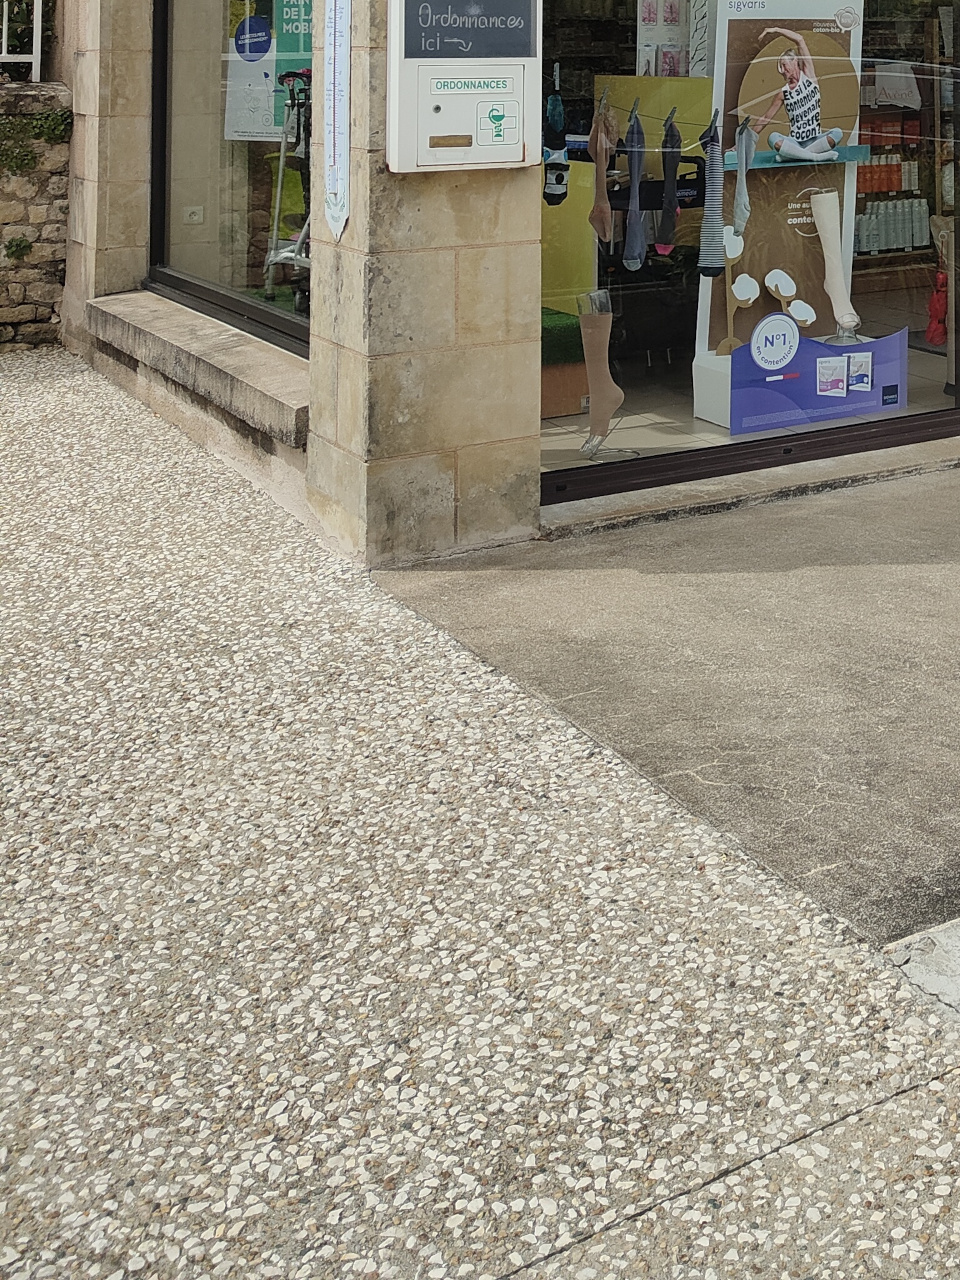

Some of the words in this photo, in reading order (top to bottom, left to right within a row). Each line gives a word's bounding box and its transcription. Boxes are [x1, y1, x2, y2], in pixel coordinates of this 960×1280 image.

[283, 7, 299, 19] DE
[418, 3, 524, 29] Ordonnances
[421, 33, 440, 51] ici
[435, 80, 508, 90] ORDONNANCES
[783, 90, 794, 100] Et
[795, 85, 803, 96] si
[802, 79, 813, 90] la
[879, 86, 914, 99] Avène
[786, 86, 820, 112] contention
[790, 98, 821, 127] devenait
[796, 112, 820, 130] votre
[787, 216, 815, 225] conten
